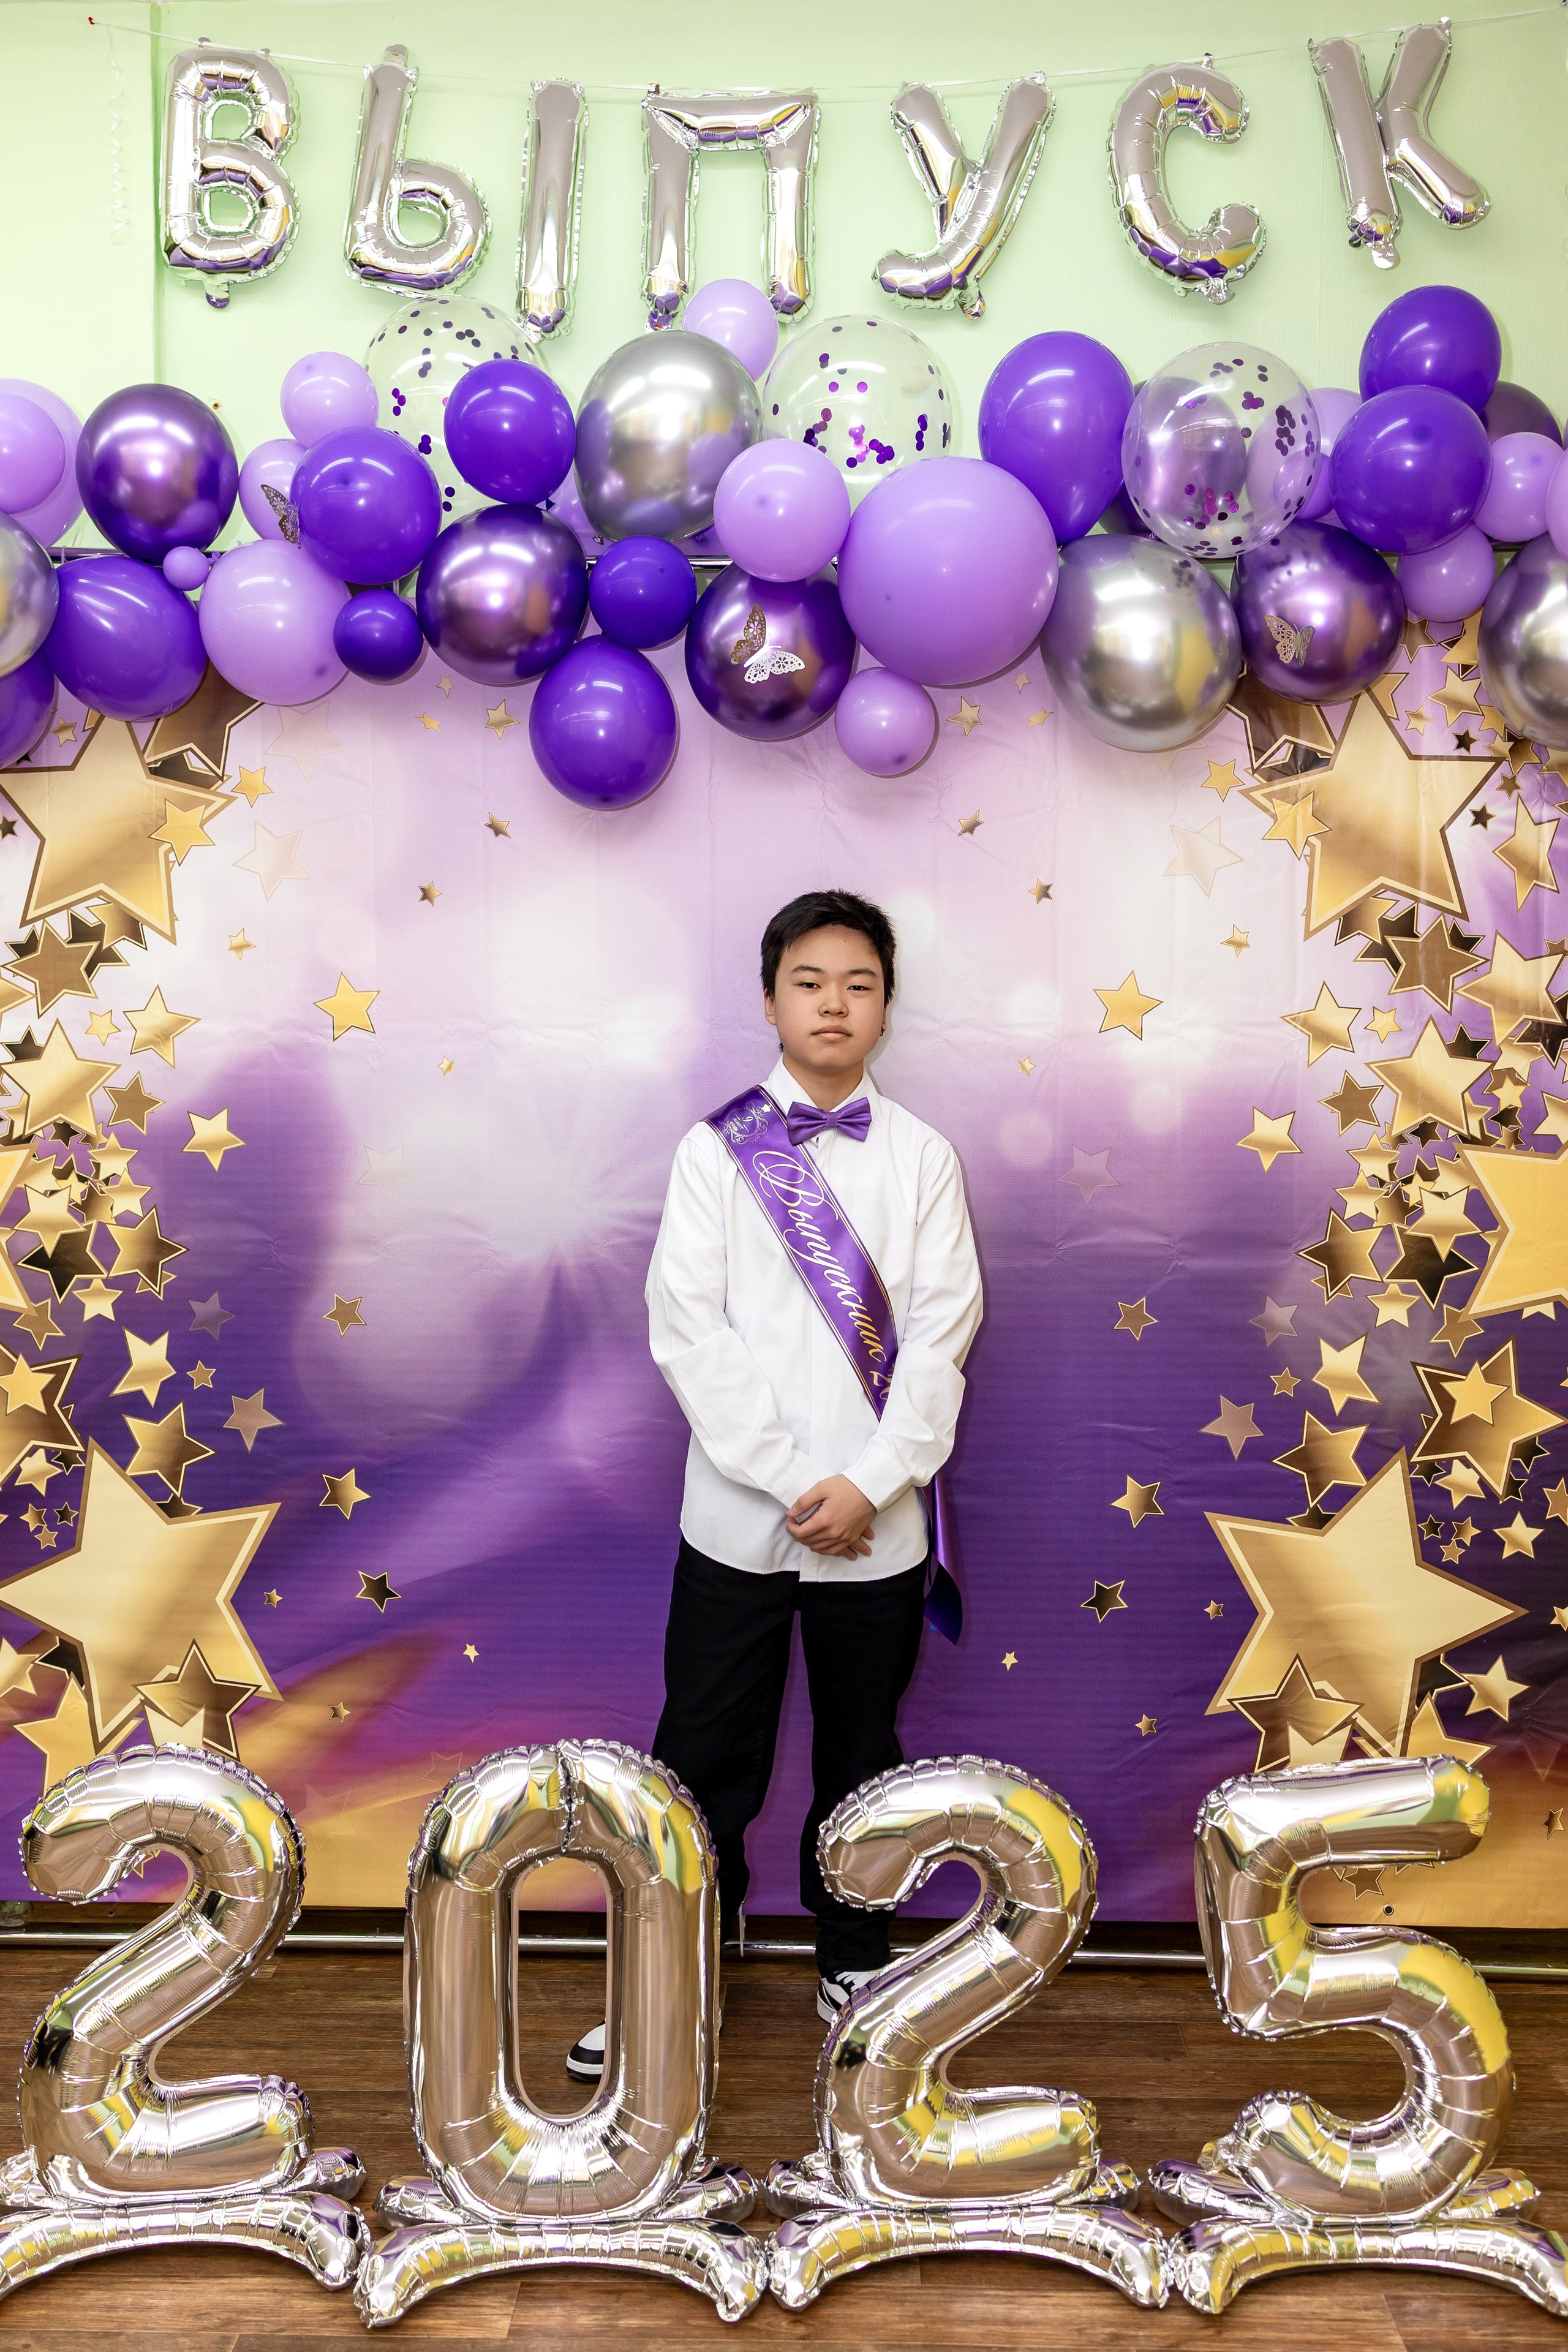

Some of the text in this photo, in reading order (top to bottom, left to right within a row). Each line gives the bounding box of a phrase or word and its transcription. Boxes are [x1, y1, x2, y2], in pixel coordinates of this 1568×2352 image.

[160, 22, 1492, 334] ВЫПУСК
[752, 1150, 887, 1363] Выпускник
[18, 1739, 1517, 2225] 2025
